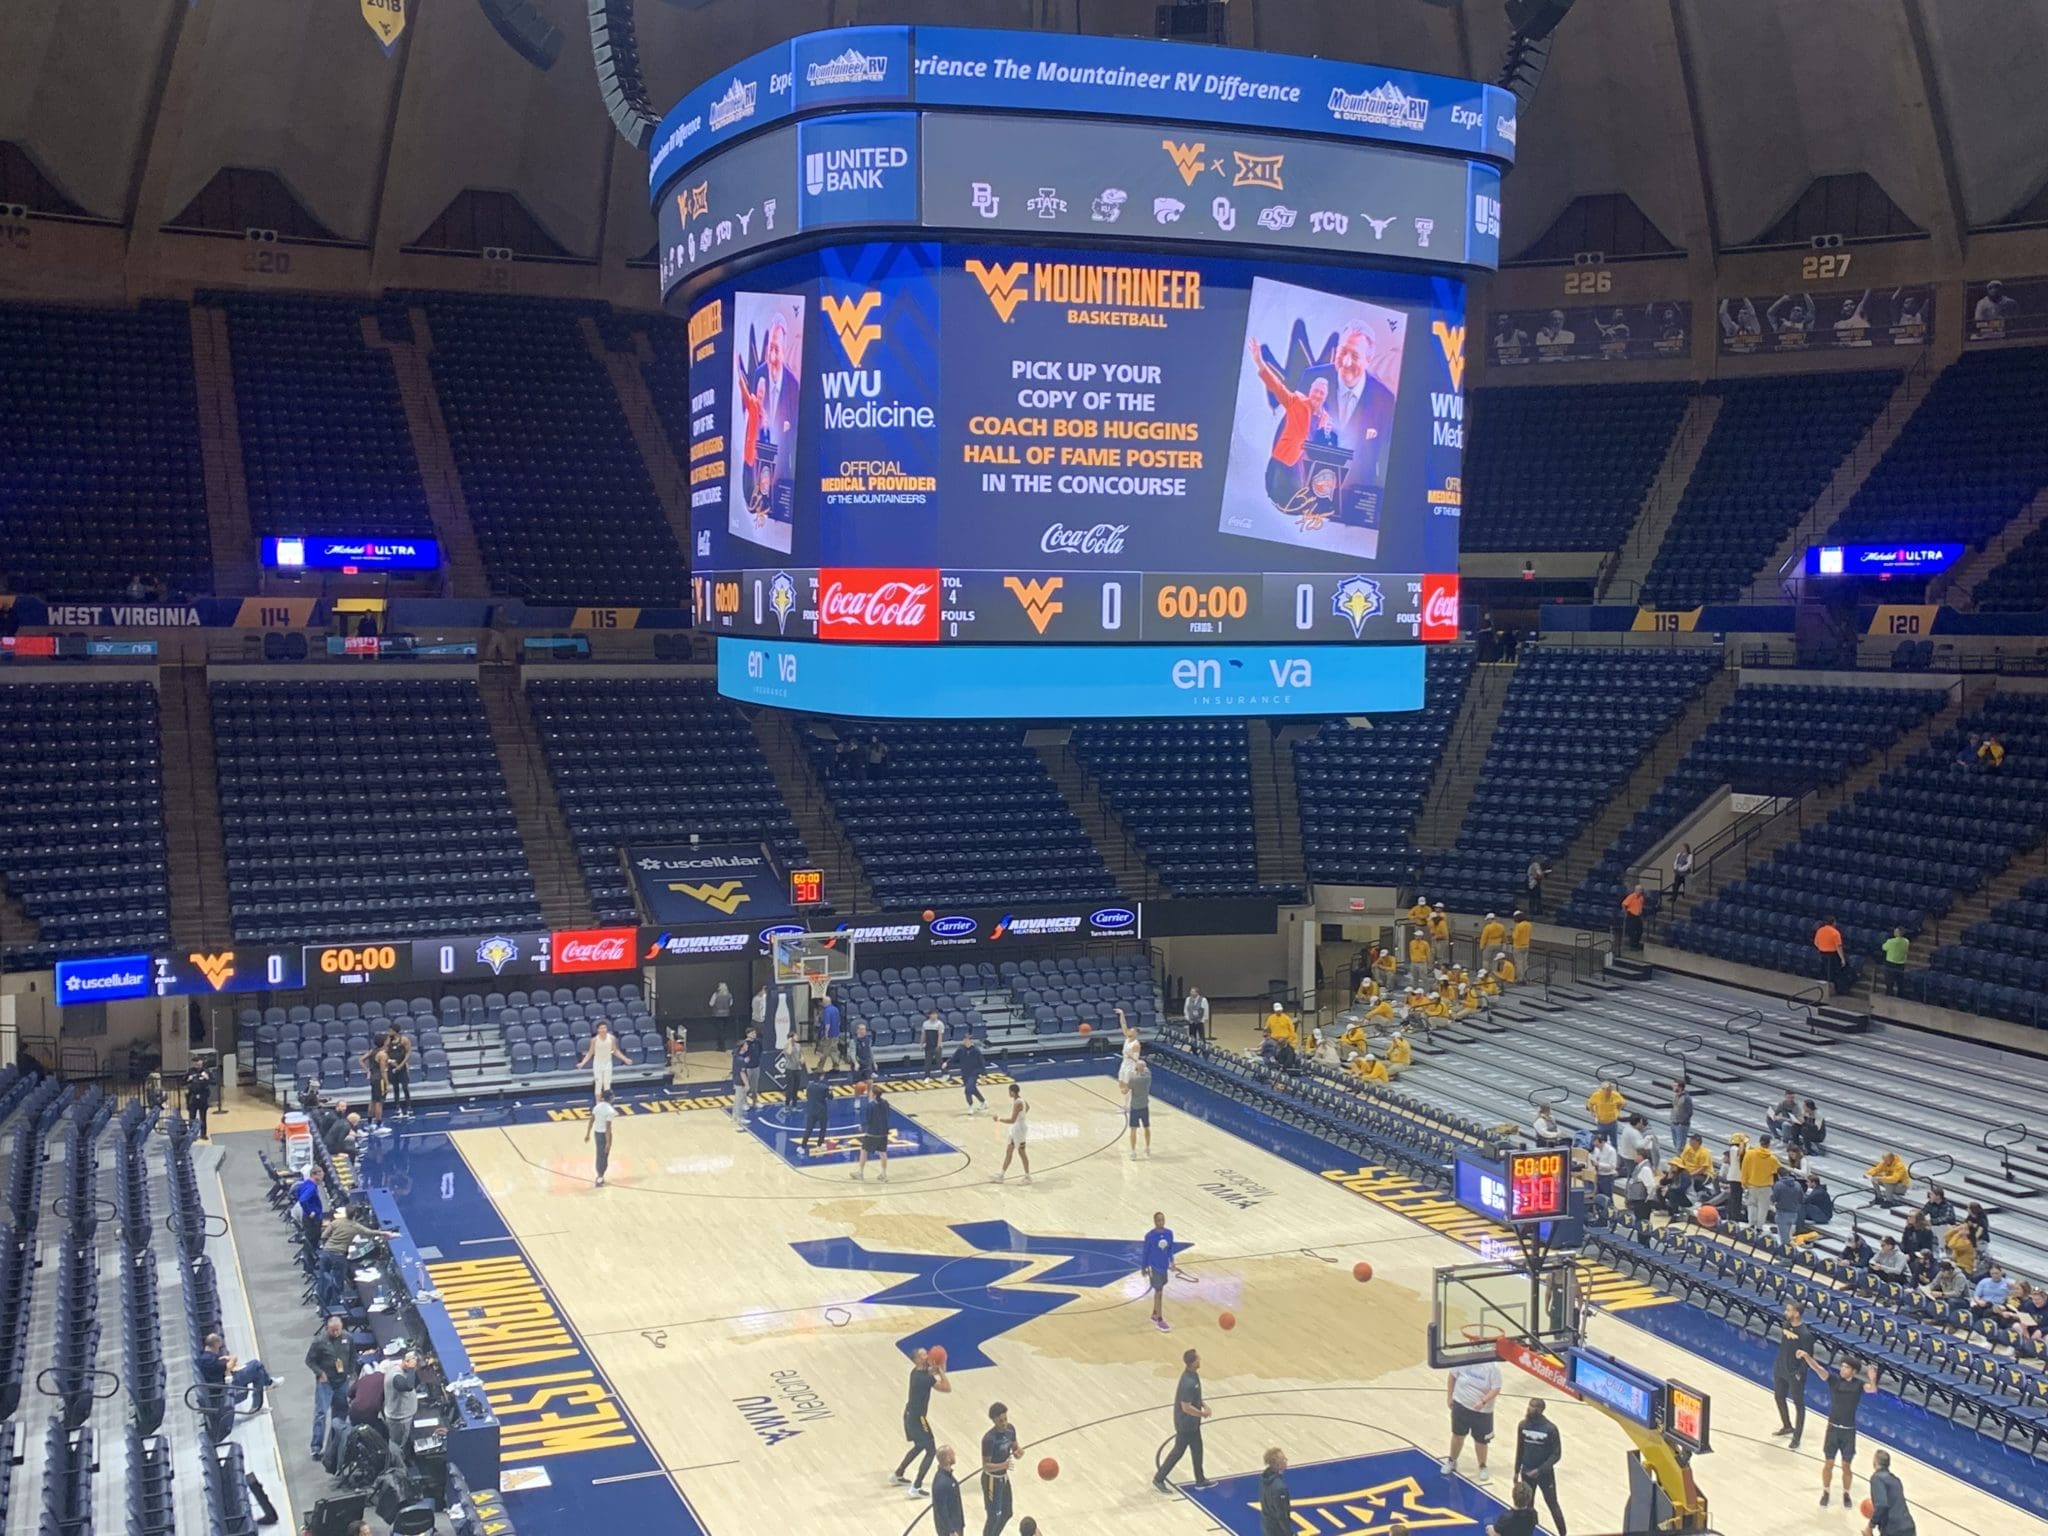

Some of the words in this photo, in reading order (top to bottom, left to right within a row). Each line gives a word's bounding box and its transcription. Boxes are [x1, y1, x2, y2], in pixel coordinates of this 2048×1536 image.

[993, 58, 1032, 80] The
[1036, 61, 1171, 90] Mountaineer
[1174, 72, 1202, 92] RV
[1204, 74, 1301, 102] Difference
[826, 147, 908, 171] UNITED
[826, 169, 884, 192] BANK
[1802, 253, 1851, 279] 227
[1034, 262, 1203, 310] MOUNTAINEER
[1564, 271, 1612, 295] 226
[1067, 309, 1168, 328] BASKETBALL
[1011, 359, 1063, 381] PICK
[1067, 361, 1097, 382] UP
[1101, 363, 1162, 384] YOUR
[821, 369, 882, 399] WVU
[1017, 388, 1078, 410] COPY
[1082, 390, 1112, 411] OF
[1115, 392, 1156, 412] THE
[824, 400, 934, 429] Medicine
[968, 415, 1048, 437] COACH
[1053, 418, 1098, 438] BOB
[1103, 420, 1199, 442] HUGGINS
[963, 445, 1021, 464] HALL
[1026, 446, 1056, 465] OF
[1060, 447, 1121, 467] FAME
[1126, 449, 1203, 469] POSTER
[840, 460, 907, 477] OFFICIAL
[821, 477, 866, 492] MEDICAL
[868, 476, 937, 492] PROVIDER
[981, 473, 1006, 493] IN
[1011, 474, 1053, 493] THE
[1057, 475, 1187, 496] CONCOURSE
[852, 493, 927, 505] MOUNTAINEERS
[375, 544, 416, 555] ULTRA
[1905, 550, 1944, 561] ULTRA
[941, 577, 963, 588] TOL
[949, 589, 957, 605] 4
[1102, 582, 1122, 630] 0
[1157, 585, 1248, 619] 60:00
[1295, 583, 1314, 630] 0
[1411, 593, 1418, 607] 4
[47, 606, 103, 626] WEST
[110, 607, 201, 627] VIRGINIA
[260, 607, 291, 627] 114
[590, 610, 618, 629] 115
[941, 610, 976, 622] FOULS
[1655, 613, 1680, 632] 119
[1888, 614, 1920, 635] 120
[950, 622, 958, 638] 0
[1412, 623, 1419, 637] 0
[1194, 695, 1292, 705] INSURANCE
[663, 855, 762, 870] uscellular
[793, 872, 820, 885] 60:00
[796, 883, 818, 901] 30
[936, 920, 972, 931] Carrier
[1008, 916, 1082, 930] ADVANCED
[1095, 913, 1131, 923] Carrier
[665, 934, 750, 949] ADVANCED
[267, 954, 282, 984] 0
[320, 946, 397, 973] 60:00
[440, 945, 454, 973] 0
[81, 972, 144, 990] uscellular
[1514, 1155, 1561, 1177] 60:00
[1519, 1176, 1556, 1211] 30
[424, 1254, 581, 1373] VIRGINIA
[769, 1369, 836, 1422] Medicine
[732, 1395, 790, 1431] WVU
